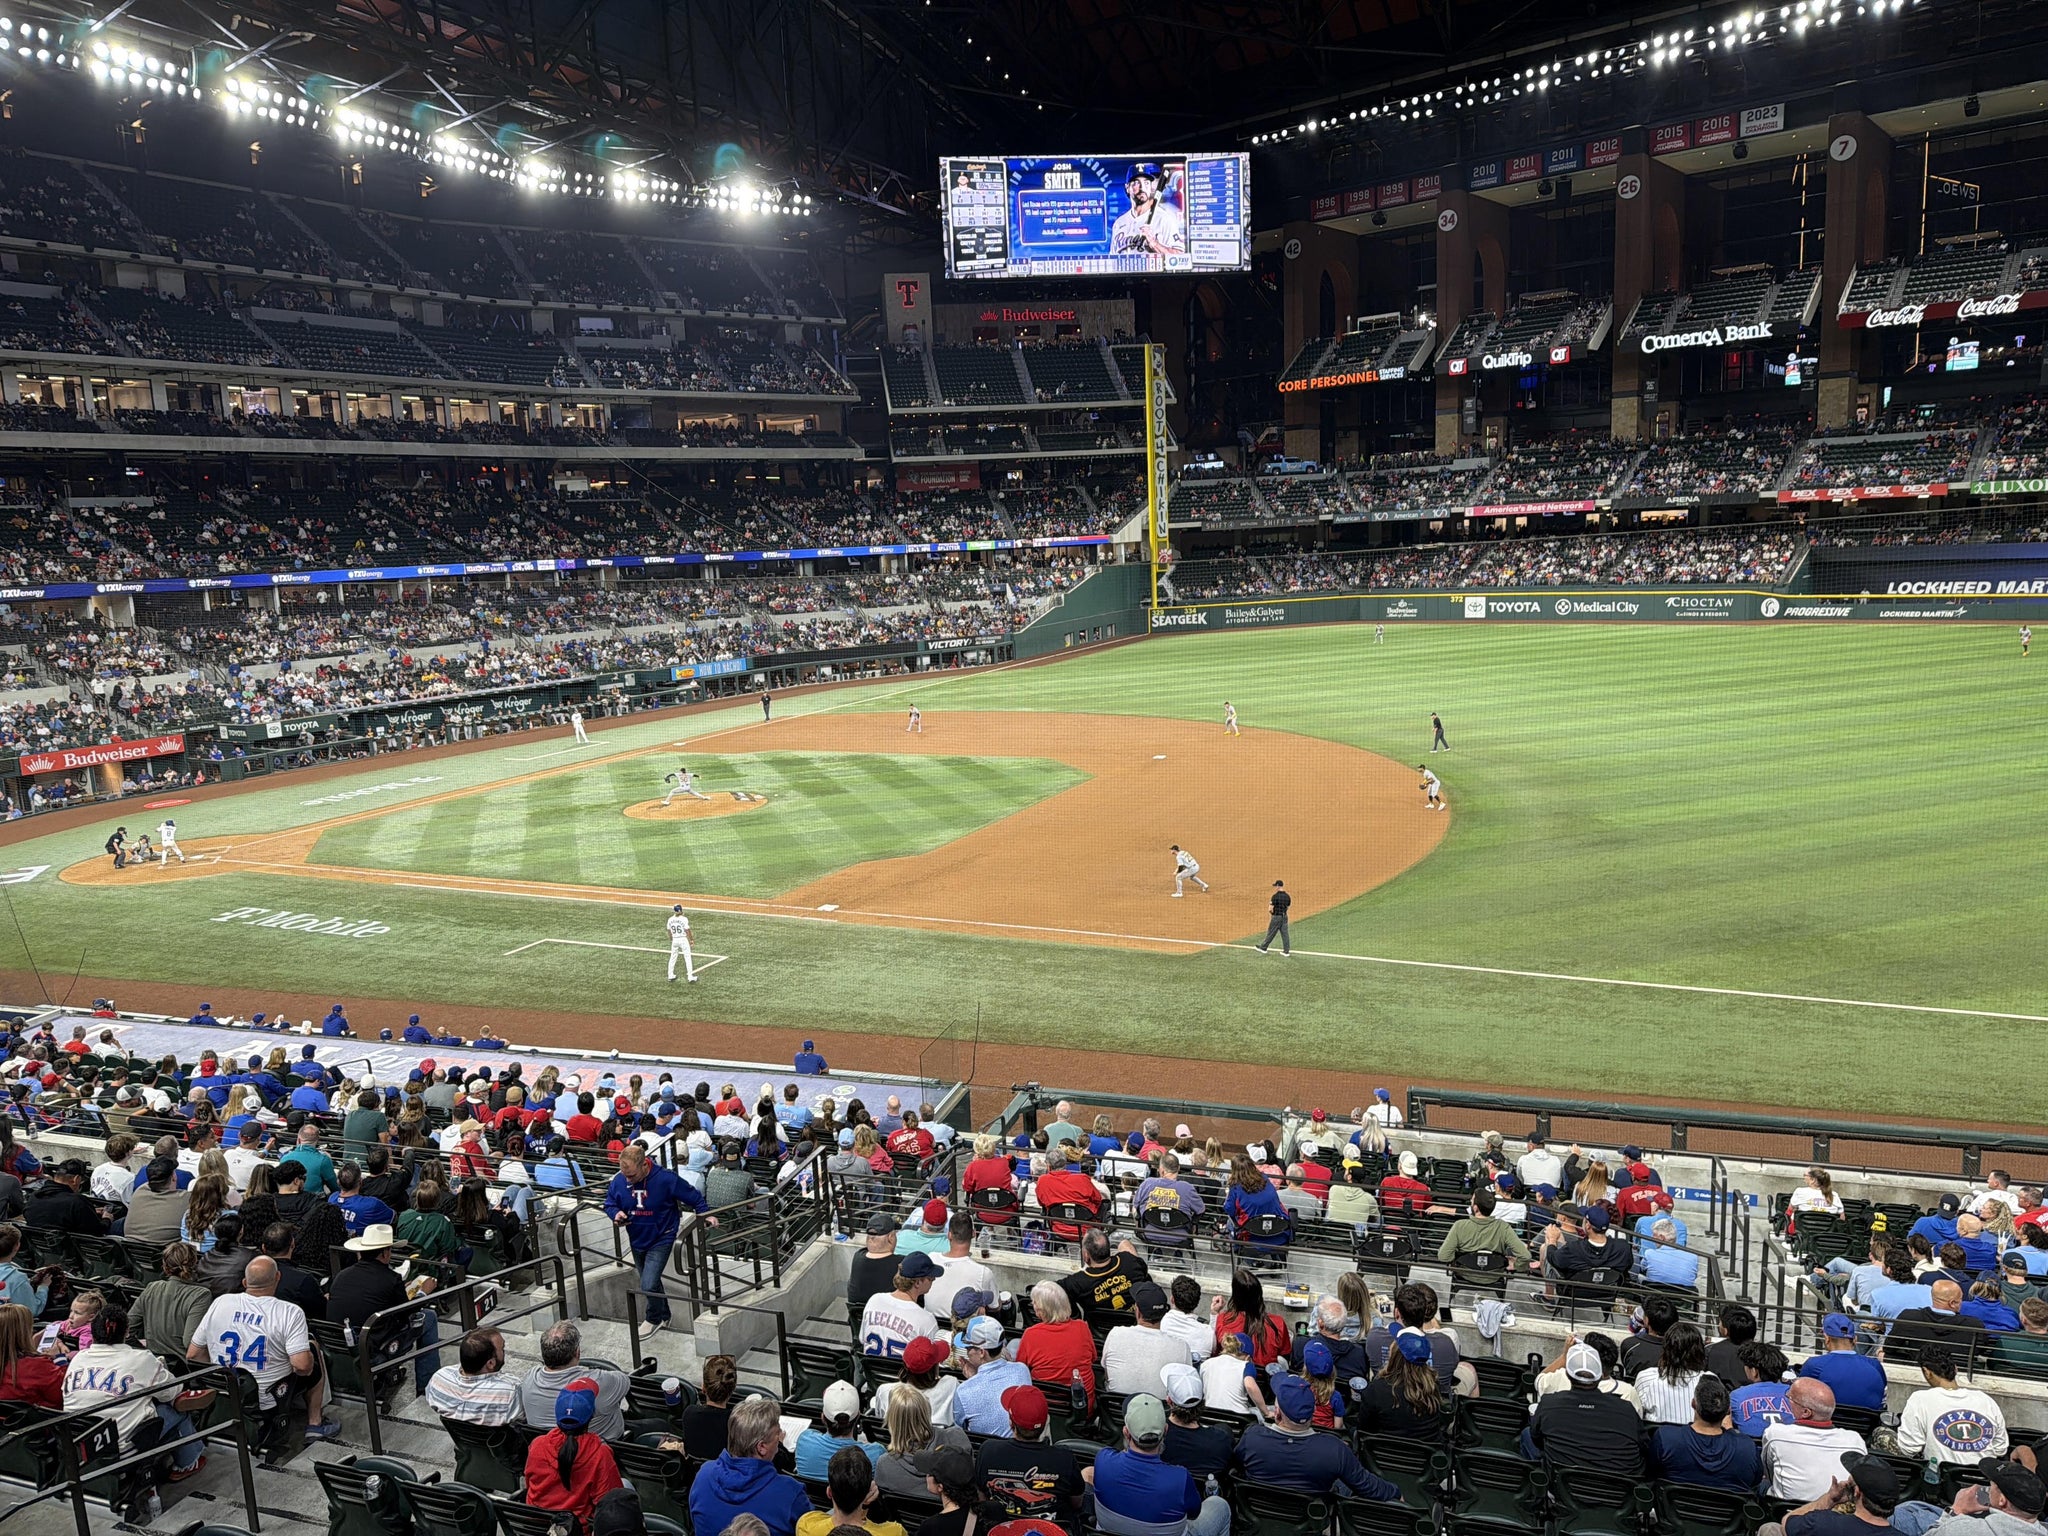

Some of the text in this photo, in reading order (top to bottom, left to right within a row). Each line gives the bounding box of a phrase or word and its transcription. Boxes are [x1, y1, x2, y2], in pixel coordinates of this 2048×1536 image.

[1747, 107, 1777, 122] 2023
[1703, 116, 1730, 131] 2016
[1657, 125, 1683, 140] 2015
[1593, 139, 1618, 153] 2012
[1838, 140, 1849, 156] 7
[1552, 148, 1573, 161] 2011
[1513, 157, 1534, 169] 2011
[1473, 164, 1495, 177] 2010
[1045, 172, 1080, 189] SMITH
[1418, 175, 1440, 188] 2010
[1620, 180, 1639, 195] 26
[1350, 190, 1369, 202] 1998
[1383, 183, 1403, 195] 1999
[1316, 197, 1335, 209] 1996
[1440, 214, 1456, 228] 34
[1285, 242, 1300, 256] 42
[896, 279, 920, 309] T
[1957, 288, 2028, 319] Coca-Cola
[1866, 304, 1928, 329] Coca-Cola
[1725, 321, 1773, 342] Bank
[1482, 351, 1532, 369] QuikTrip
[1551, 348, 1567, 362] QT
[1450, 361, 1464, 373] QT
[1279, 370, 1379, 393] CORE PERSONNEL
[1791, 484, 1930, 497] DEX DEX DEX DEX
[1157, 461, 1167, 536] CHIKIN
[1665, 495, 1700, 503] ARENA
[1484, 505, 1525, 513] America's
[1547, 502, 1584, 511] Network
[1887, 581, 1992, 594] LOCKHEED
[1489, 602, 1541, 612] TOYOTA
[1573, 602, 1639, 615] Medical City
[1669, 597, 1733, 607] CHOCTAW
[1225, 606, 1285, 619] Bailey&Galyen
[1784, 607, 1853, 617] PROGRESSIVE
[1152, 612, 1207, 627] SEATGEEK
[928, 638, 970, 650] VICTORY
[454, 702, 484, 716] Kroger
[504, 695, 532, 712] Kroger
[401, 709, 432, 727] Kroger
[284, 721, 319, 732] TOYOTA
[63, 747, 148, 768] Budweiser
[671, 925, 682, 935] 96
[632, 1189, 648, 1208] T
[1674, 1188, 1686, 1198] 21
[1094, 1274, 1127, 1294] CHICO'S
[1094, 1280, 1133, 1302] BAIL BONDS
[484, 1295, 494, 1311] 21
[233, 1311, 264, 1326] RYAN
[868, 1310, 914, 1338] LECLERC
[218, 1330, 269, 1371] 34
[865, 1332, 908, 1359] 25
[1739, 1396, 1796, 1421] TEXA
[1939, 1411, 1986, 1427] TEXAS
[1936, 1428, 1945, 1436] 19
[1956, 1424, 1971, 1439] T
[1985, 1427, 1993, 1435] 72
[93, 1427, 111, 1452] 21
[1944, 1437, 1989, 1450] RANGERS
